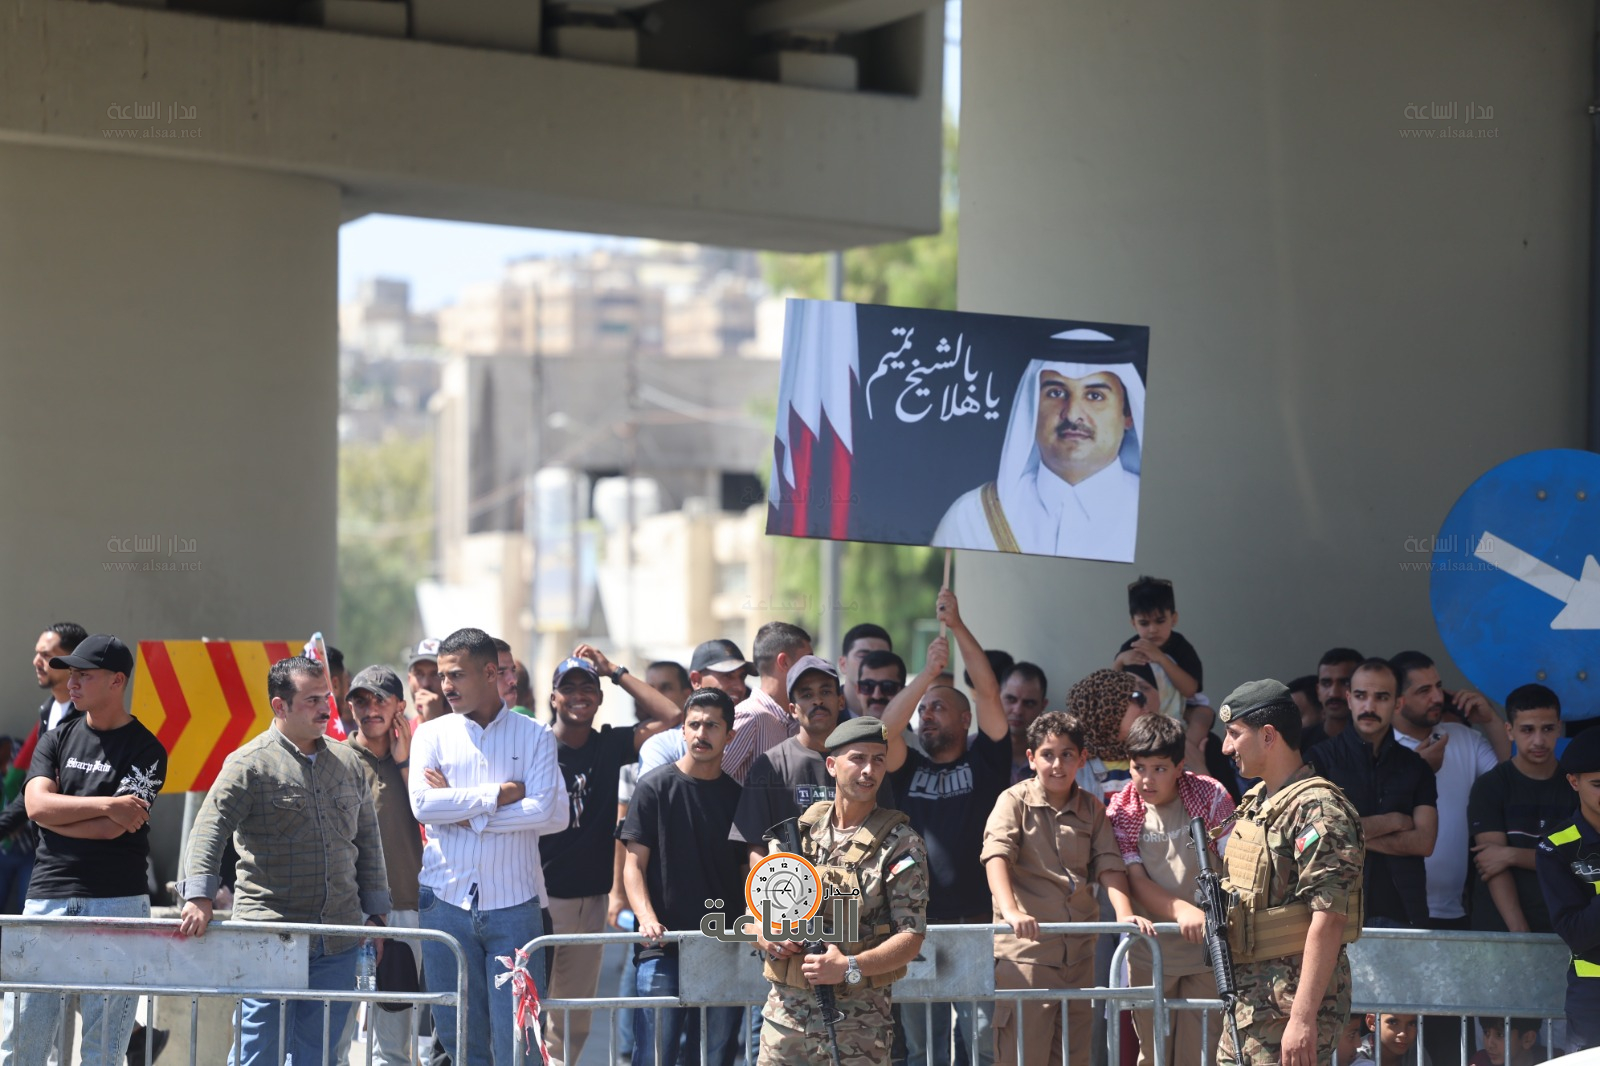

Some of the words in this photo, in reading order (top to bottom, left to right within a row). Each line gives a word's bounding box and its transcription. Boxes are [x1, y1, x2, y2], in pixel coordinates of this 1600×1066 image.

[866, 327, 915, 420] تميم
[895, 332, 978, 423] بالشيخ
[799, 790, 810, 798] Ti
[908, 764, 974, 796] PUMA
